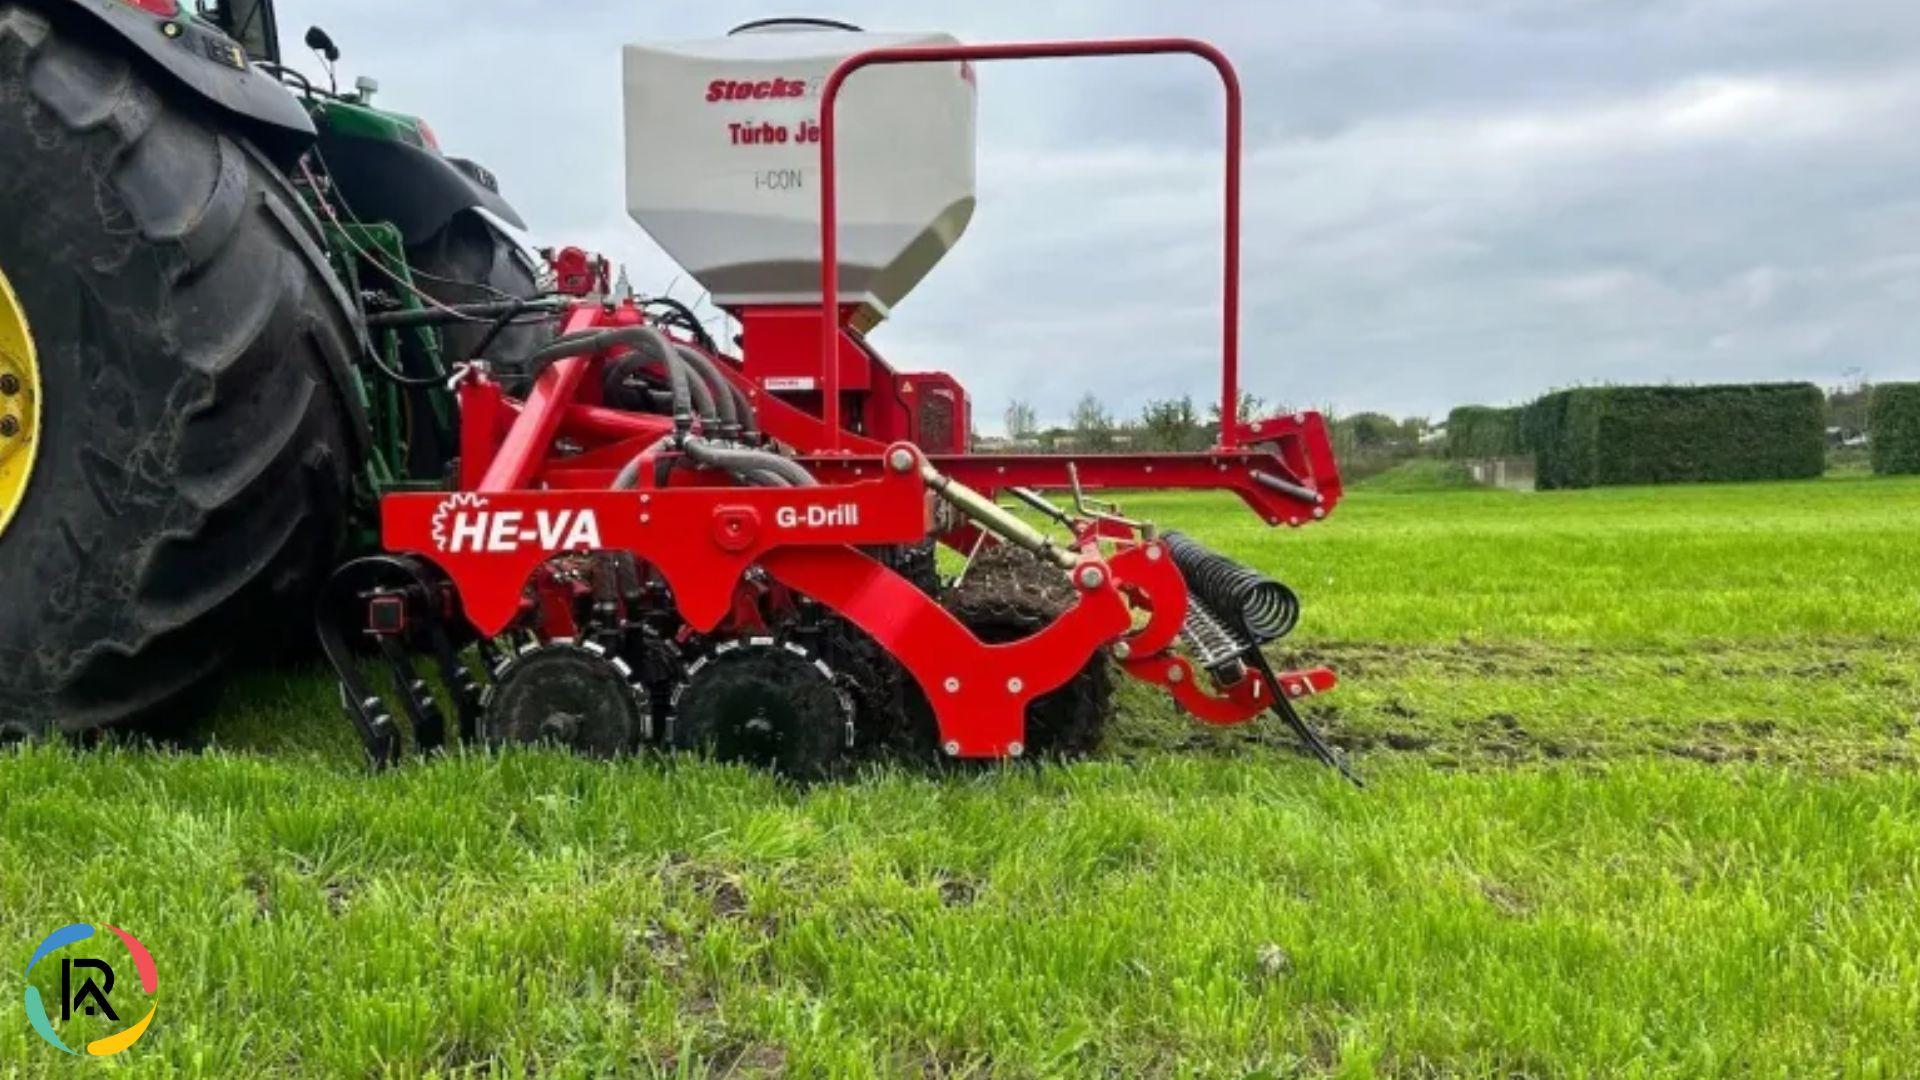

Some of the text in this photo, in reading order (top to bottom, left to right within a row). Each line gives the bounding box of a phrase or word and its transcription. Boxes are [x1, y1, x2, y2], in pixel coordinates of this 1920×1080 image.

[705, 77, 806, 102] Stocks
[728, 120, 821, 144] Turbo Je
[755, 169, 803, 190] i-CON
[777, 503, 859, 528] G-Drill
[450, 509, 602, 552] HE-VA
